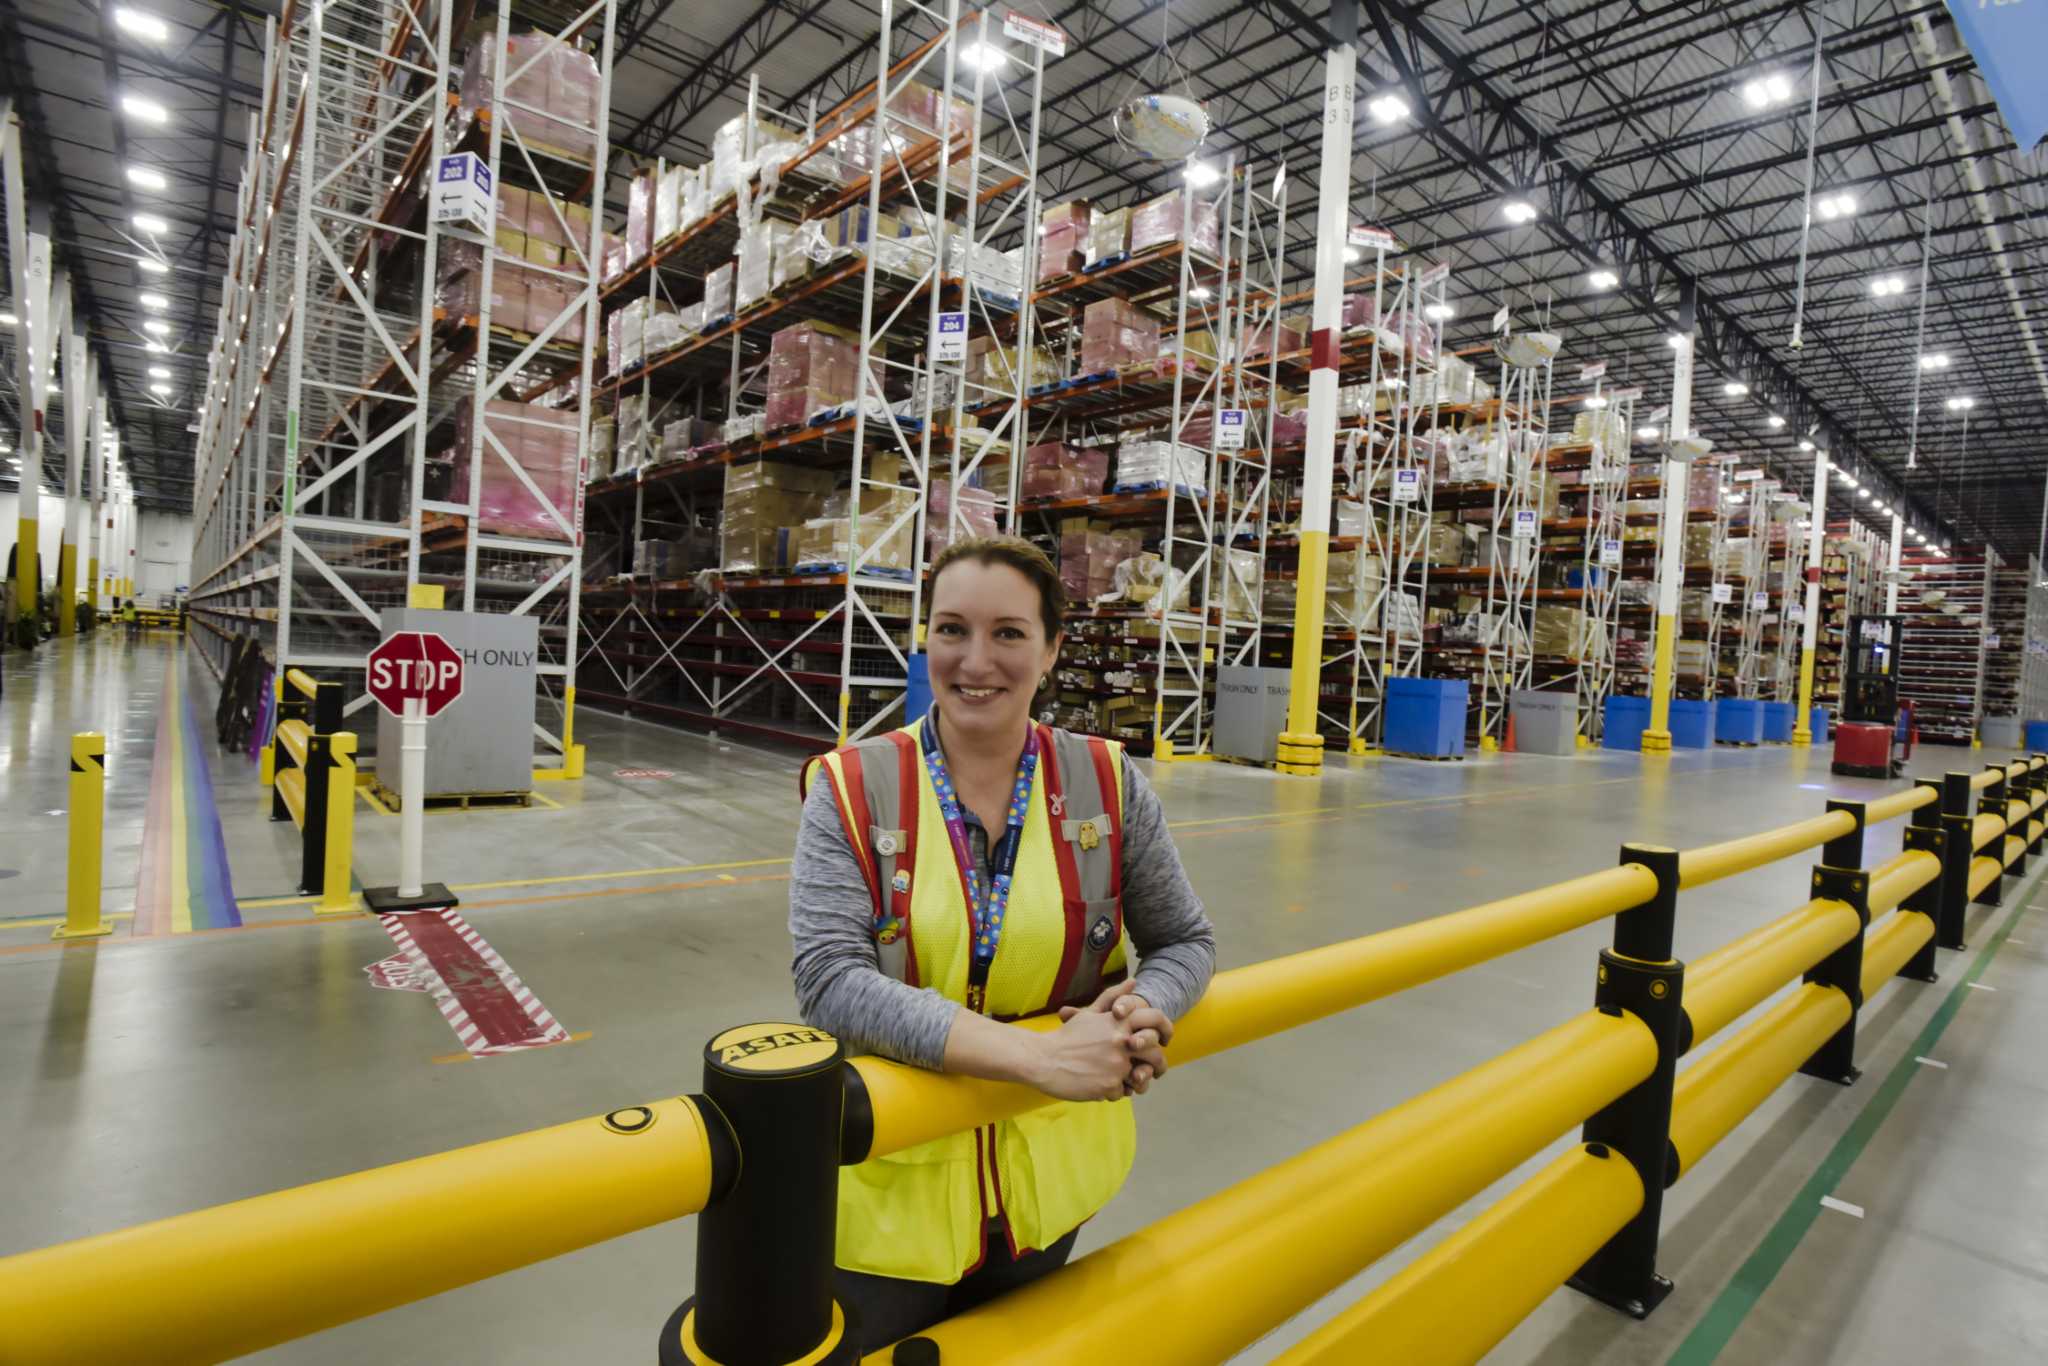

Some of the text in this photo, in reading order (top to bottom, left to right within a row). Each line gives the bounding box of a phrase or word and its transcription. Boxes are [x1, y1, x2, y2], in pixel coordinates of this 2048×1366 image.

[943, 321, 960, 331] 204
[483, 649, 535, 667] ONLY
[372, 658, 459, 691] STOP
